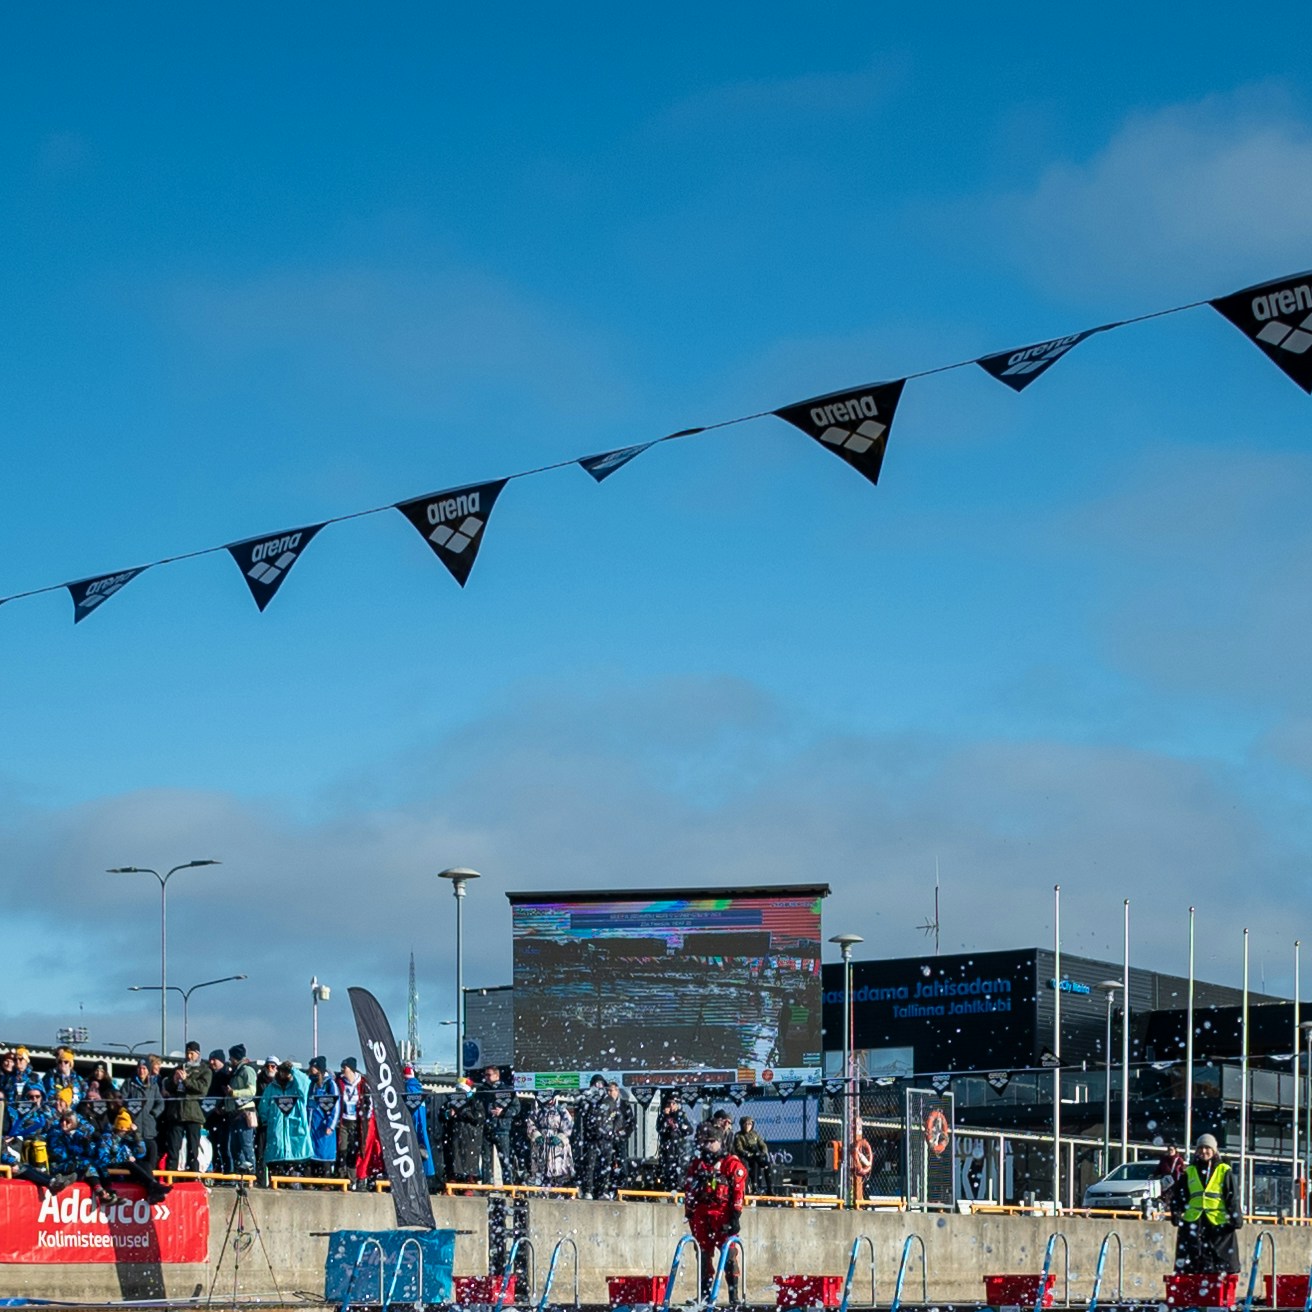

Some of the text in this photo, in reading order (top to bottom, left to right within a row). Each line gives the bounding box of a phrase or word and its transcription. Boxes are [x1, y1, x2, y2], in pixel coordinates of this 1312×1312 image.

[1007, 333, 1081, 366] arena
[810, 395, 879, 428] arena
[427, 491, 481, 526] arena
[251, 531, 303, 562] arena
[373, 1039, 415, 1179] dryrobe
[38, 1230, 150, 1248] Kolimisteenused
